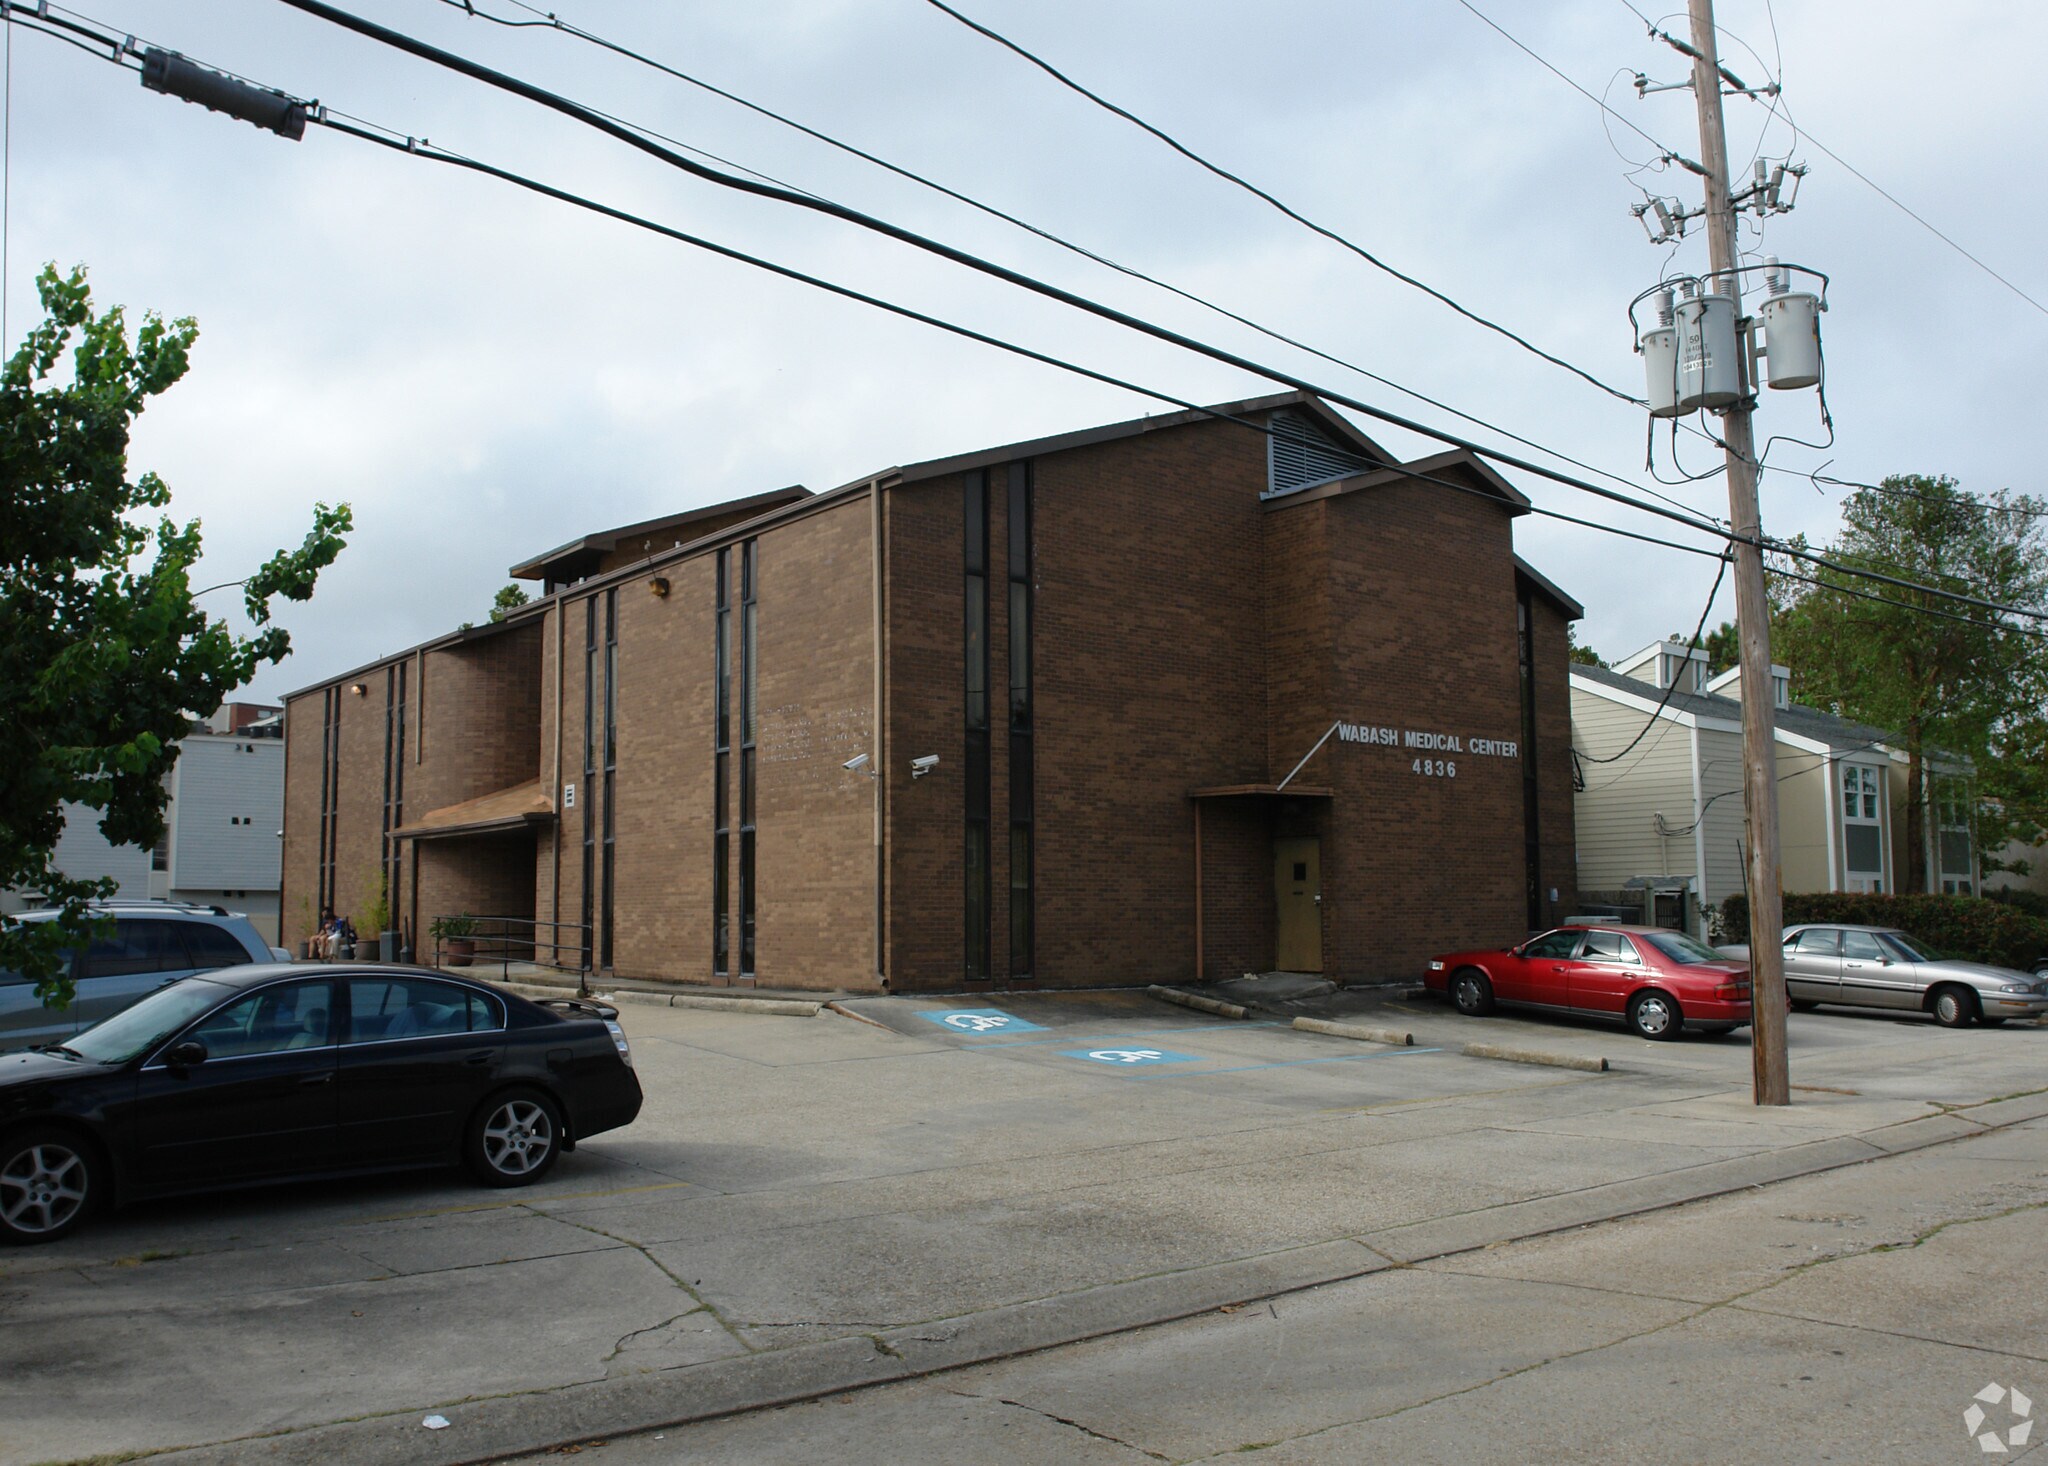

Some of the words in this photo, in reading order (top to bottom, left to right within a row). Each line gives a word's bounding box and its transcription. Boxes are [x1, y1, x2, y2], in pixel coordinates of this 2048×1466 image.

[1689, 334, 1700, 344] 50
[1338, 724, 1399, 746] WABASH
[1405, 731, 1463, 752] MEDICAL
[1469, 738, 1517, 757] CENTER
[1412, 759, 1456, 777] 4836
